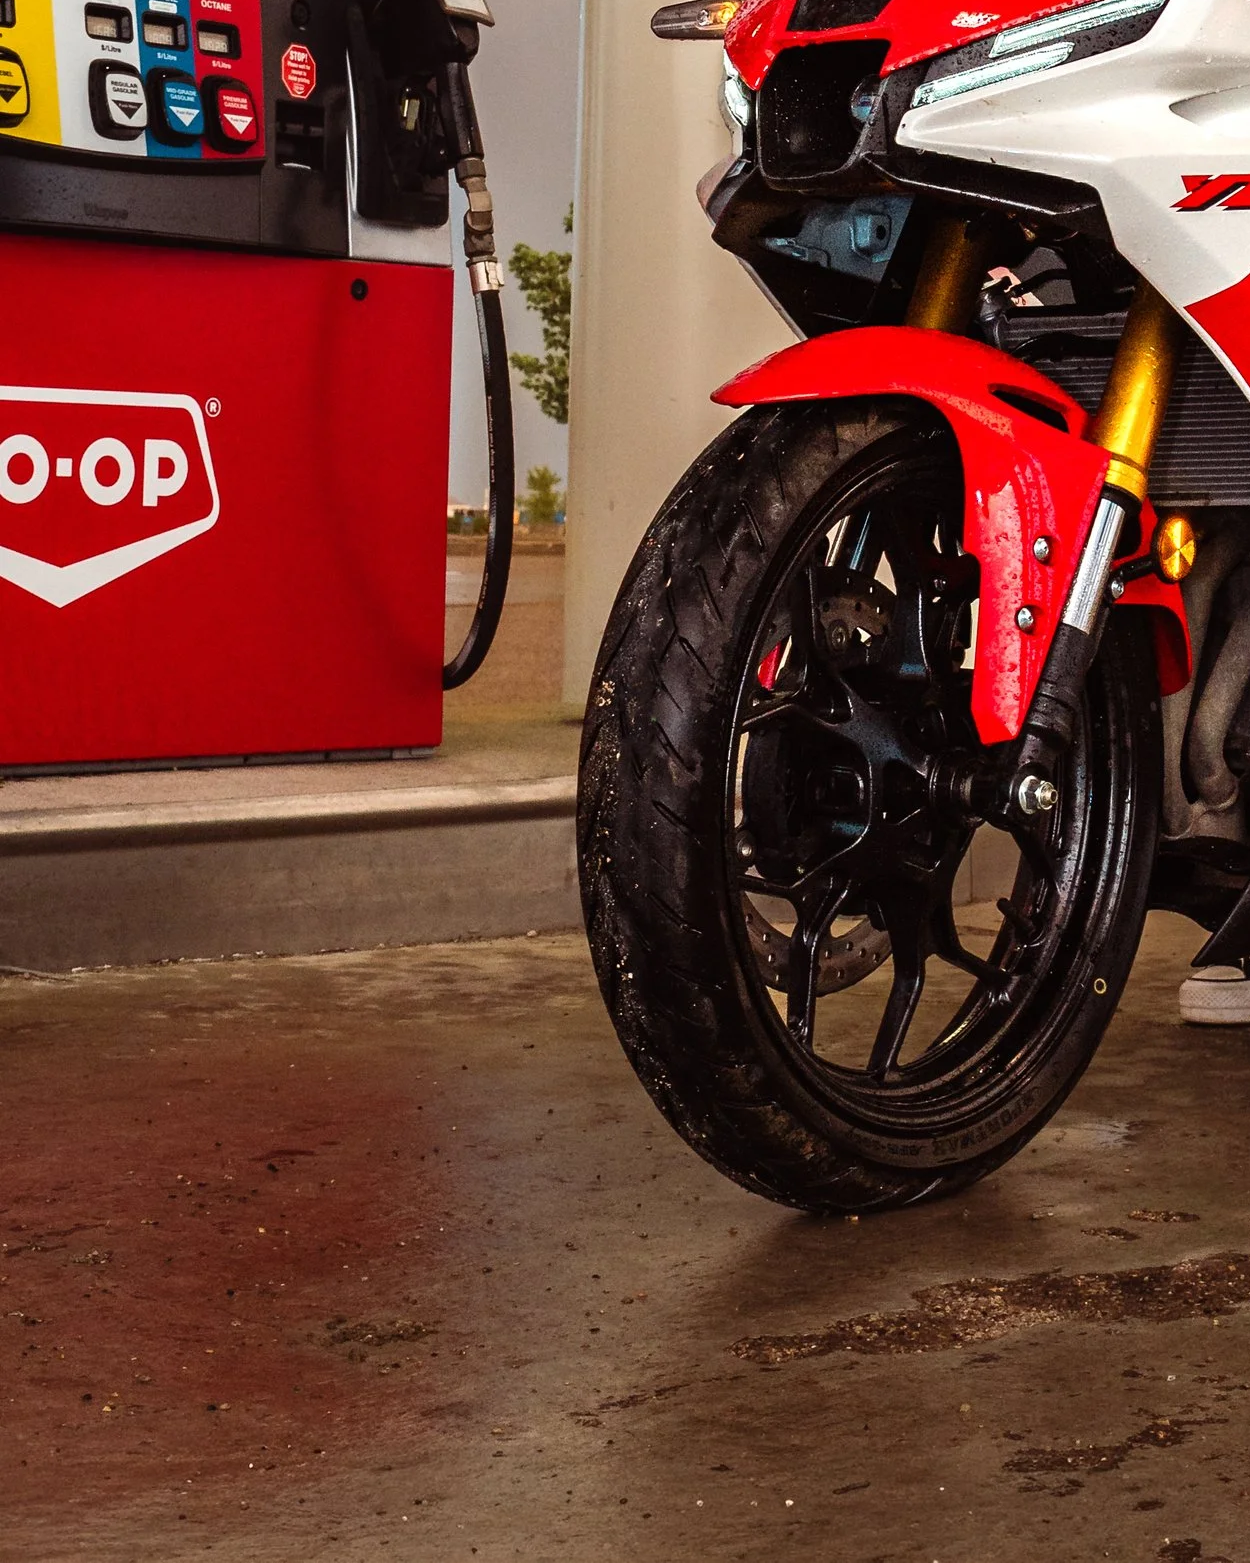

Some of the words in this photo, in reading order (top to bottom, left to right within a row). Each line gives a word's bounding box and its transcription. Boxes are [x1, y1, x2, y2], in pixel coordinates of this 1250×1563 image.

[200, 0, 232, 12] OCTANE
[290, 50, 308, 63] STOP!
[111, 80, 138, 88] REGULAR
[112, 87, 138, 95] GASOLINE
[166, 87, 197, 97] MID-GRADE
[170, 93, 195, 102] GASOLINE
[223, 95, 248, 104] PREMIUM
